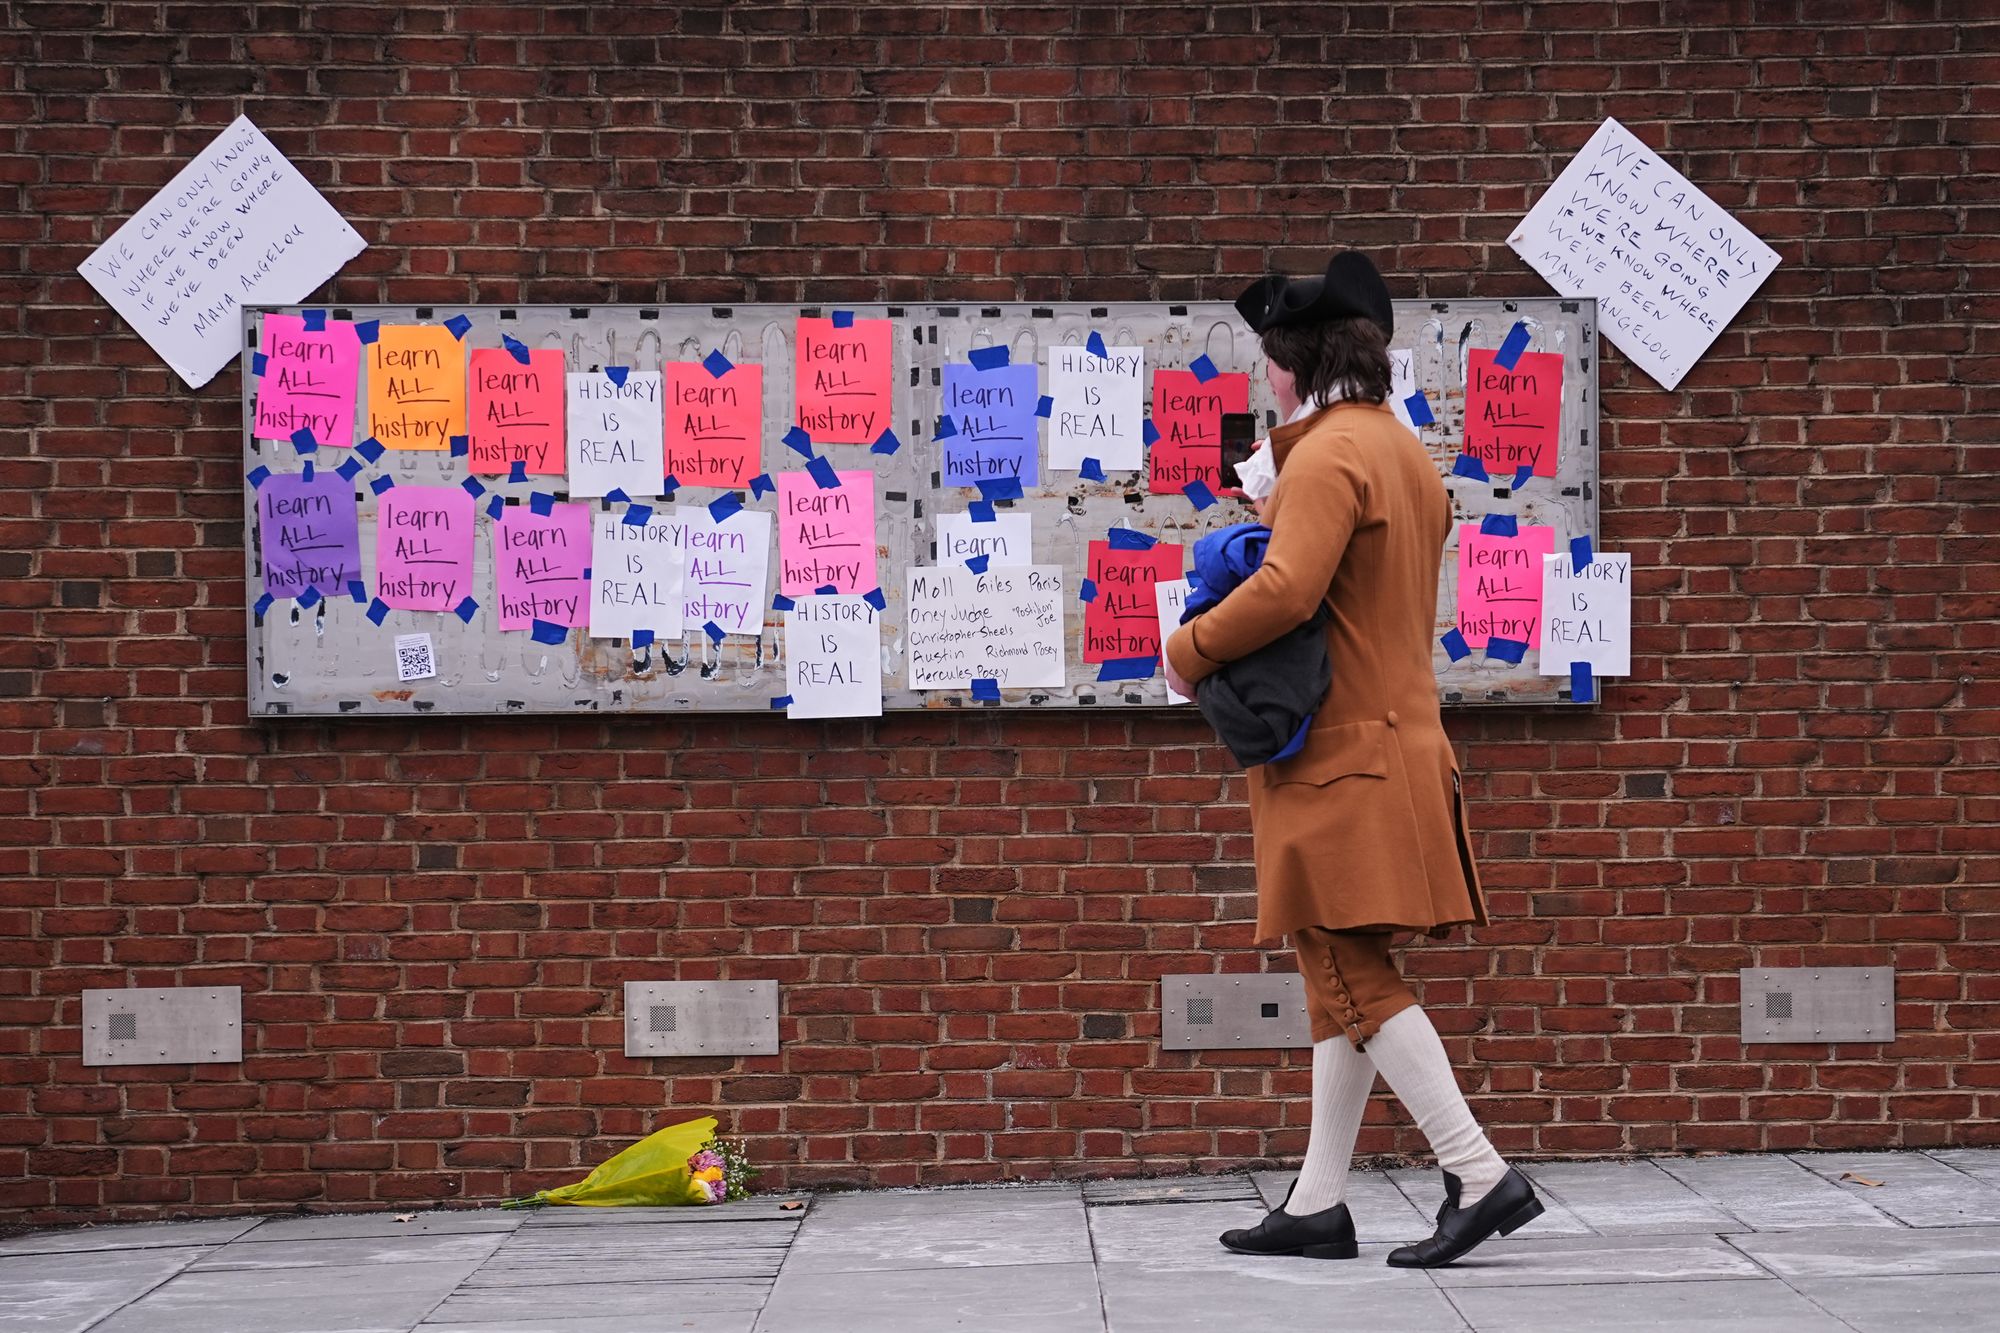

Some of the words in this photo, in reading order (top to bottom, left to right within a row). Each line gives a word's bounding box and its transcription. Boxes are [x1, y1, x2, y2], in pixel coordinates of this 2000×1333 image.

[98, 243, 134, 279] WE
[141, 208, 173, 241] CAN
[177, 173, 216, 209] ONLY
[211, 132, 254, 174] KNOW
[1601, 134, 1650, 180] WE
[1654, 180, 1705, 221] CAN
[1709, 228, 1760, 279] ONLY
[122, 244, 177, 298] WHERE
[178, 197, 222, 240] WE'RE
[231, 154, 272, 192] GOING
[1584, 164, 1649, 215] KNOW
[1654, 217, 1731, 289] WHERE
[142, 293, 154, 312] IF
[165, 264, 186, 287] WE
[189, 221, 231, 261] KNOW
[236, 170, 284, 216] WHERE
[1571, 190, 1642, 249] WE'RE
[1654, 252, 1709, 299] GOING
[158, 280, 202, 327] WE'VE
[208, 228, 245, 271] BEEN
[193, 293, 237, 338] MAYA
[240, 224, 305, 293] ANGELOU
[1548, 220, 1607, 274] WE'VE
[1619, 280, 1670, 321] BEEN
[1558, 205, 1574, 218] IF
[1581, 222, 1606, 245] WE
[1610, 245, 1655, 281] KNOW
[1661, 284, 1719, 333] WHERE
[1539, 251, 1584, 291] MAYA
[1598, 296, 1672, 363] ANGELOU
[272, 332, 334, 364] learn
[377, 344, 440, 371] learn
[806, 337, 867, 362] learn
[278, 368, 326, 391] ALL
[387, 377, 434, 400] ALL
[478, 367, 540, 394] learn
[815, 370, 861, 392] ALL
[1477, 368, 1537, 395] learn
[675, 380, 737, 407] learn
[952, 382, 1014, 408] learn
[1085, 386, 1101, 405] IS
[1163, 388, 1223, 416] learn
[260, 401, 338, 440] history
[487, 400, 533, 423] ALL
[603, 412, 620, 432] IS
[684, 414, 730, 435] ALL
[800, 405, 875, 438] history
[1483, 400, 1529, 422] ALL
[372, 413, 449, 445] history
[962, 414, 1007, 436] ALL
[1060, 411, 1124, 439] REAL
[1170, 421, 1216, 443] ALL
[472, 436, 548, 469] history
[580, 439, 644, 464] REAL
[1467, 435, 1542, 466] history
[668, 449, 744, 483] history
[947, 451, 1022, 478] history
[267, 493, 332, 519] learn
[387, 503, 450, 531] learn
[788, 491, 850, 516] learn
[280, 524, 327, 547] ALL
[395, 536, 443, 560] ALL
[503, 525, 567, 551] learn
[685, 524, 744, 553] learn
[799, 523, 845, 546] ALL
[947, 532, 1008, 558] learn
[515, 557, 562, 579] ALL
[627, 554, 643, 574] IS
[690, 558, 736, 581] ALL
[1468, 543, 1529, 569] learn
[266, 561, 344, 591] history
[785, 558, 860, 589] history
[912, 576, 953, 601] Moll
[976, 575, 1013, 594] Giles
[1028, 571, 1061, 592] Paris
[1098, 559, 1157, 586] learn
[379, 572, 456, 607] history
[602, 579, 666, 606] REAL
[1477, 576, 1523, 598] ALL
[501, 593, 578, 623] history
[686, 594, 749, 628] istory
[797, 602, 875, 624] HISTORY
[1104, 592, 1150, 615] ALL
[1572, 592, 1588, 611] IS
[911, 608, 947, 631] Oney
[951, 604, 992, 626] Judge
[1036, 613, 1056, 628] Joe
[1461, 610, 1536, 642] history
[1552, 618, 1612, 644] REAL
[821, 635, 838, 654] IS
[913, 649, 965, 664] Austin
[985, 643, 1029, 659] Richmond
[1033, 641, 1058, 662] Posey
[798, 661, 862, 688] REAL
[915, 666, 973, 685] Hercules
[977, 664, 1009, 683] Posey
